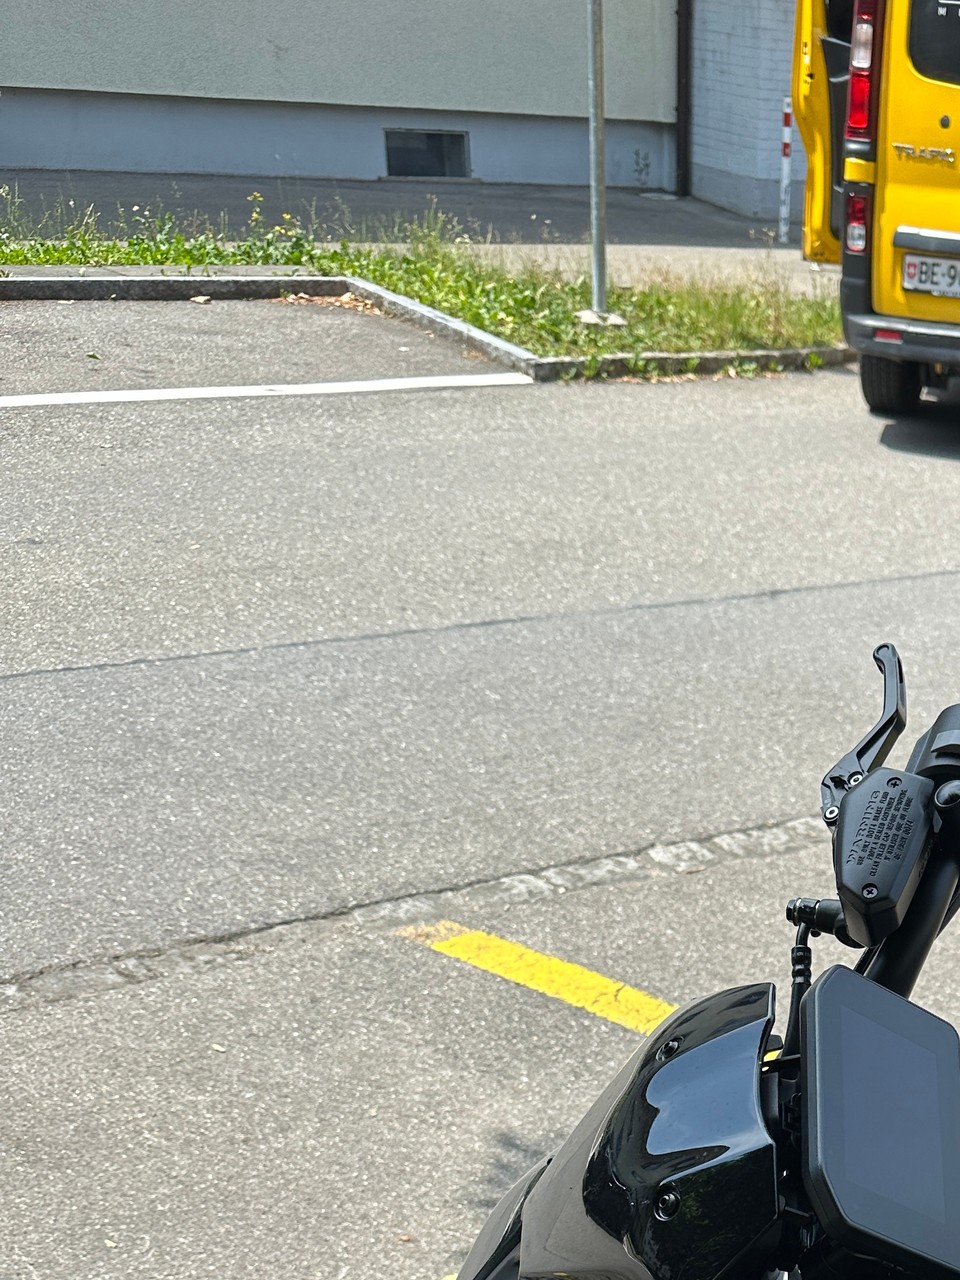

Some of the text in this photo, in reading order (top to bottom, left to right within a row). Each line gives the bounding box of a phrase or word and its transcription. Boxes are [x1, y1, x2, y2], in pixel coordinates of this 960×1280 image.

[846, 789, 880, 866] WARNING
[866, 822, 877, 839] DOT4
[874, 821, 886, 841] SEALED
[875, 843, 887, 860] FILLER
[882, 831, 891, 843] CAP
